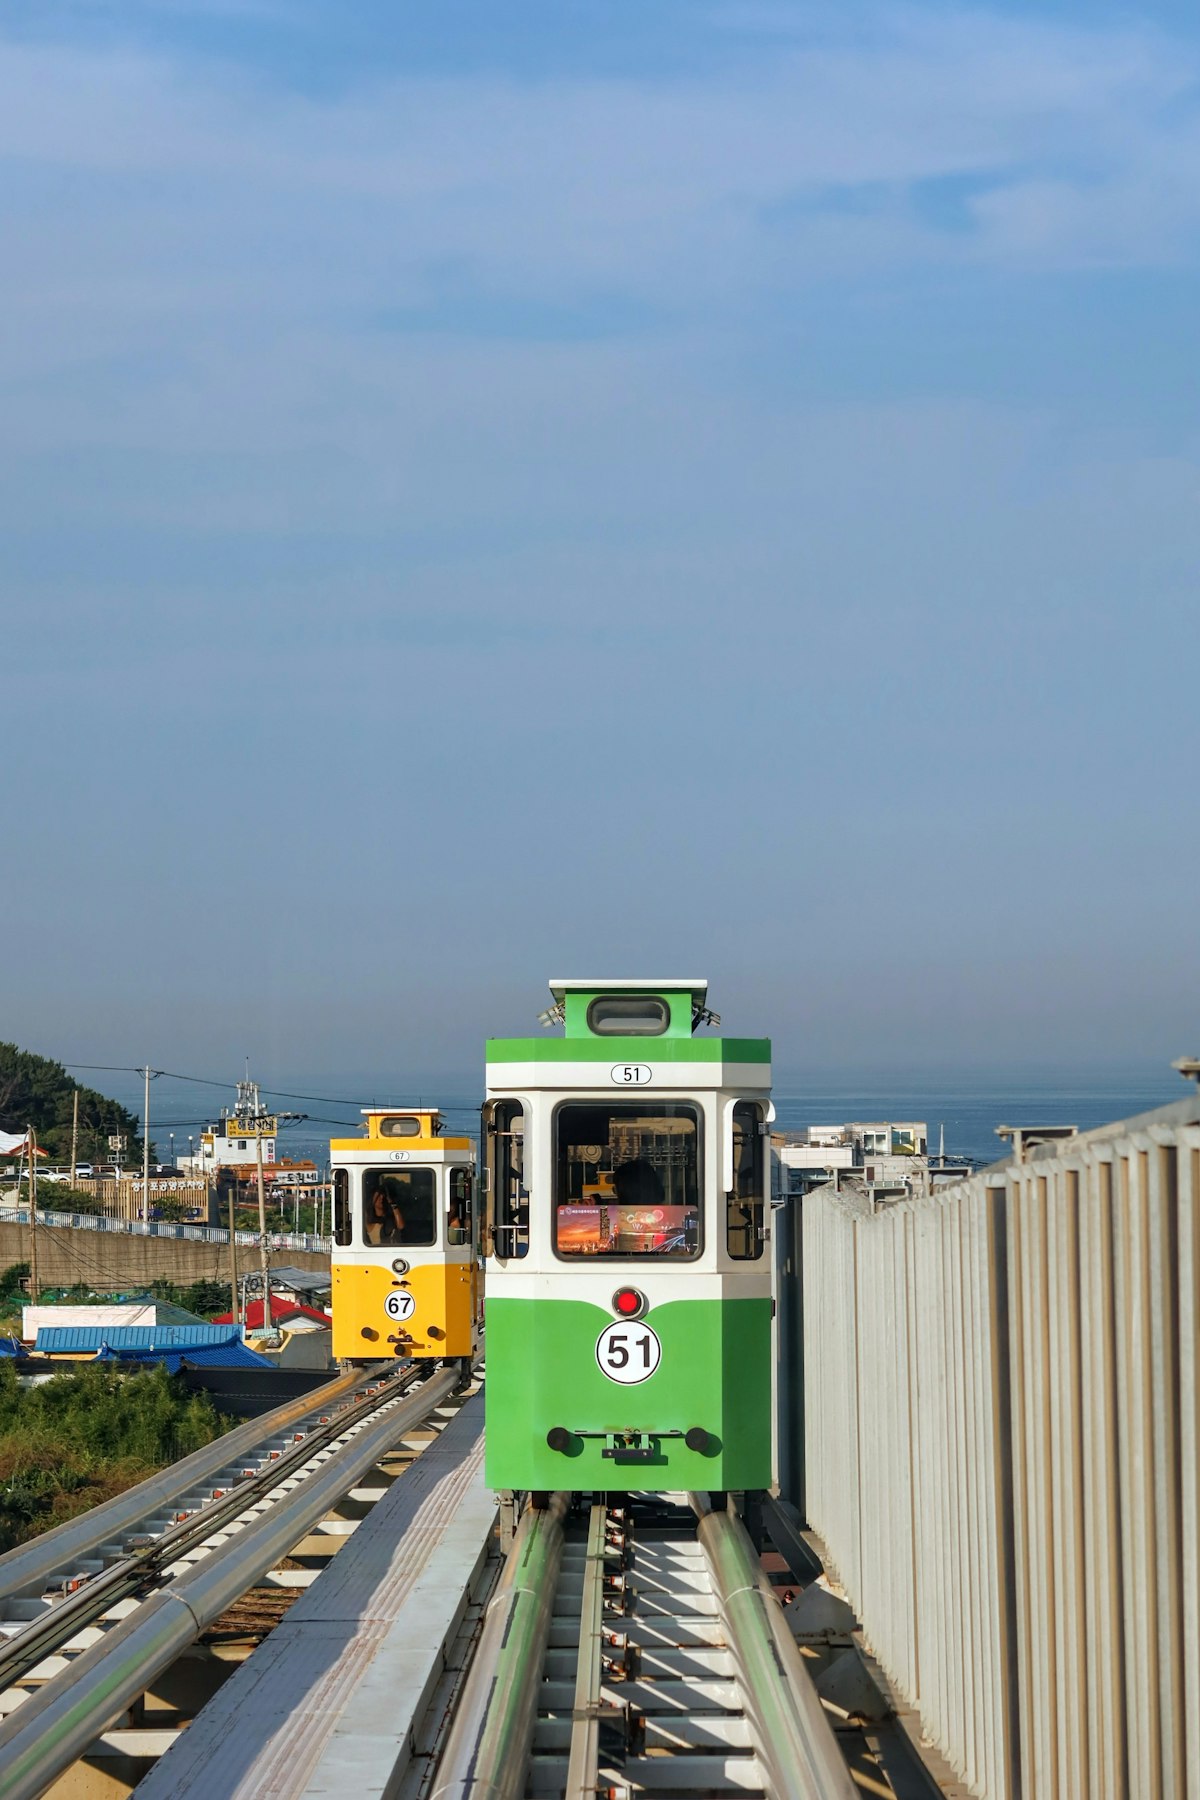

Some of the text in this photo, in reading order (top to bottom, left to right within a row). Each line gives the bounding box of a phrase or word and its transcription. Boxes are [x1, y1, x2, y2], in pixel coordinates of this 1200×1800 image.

[624, 1067, 639, 1082] 51
[395, 1152, 404, 1160] 67
[388, 1297, 411, 1314] 67
[607, 1335, 650, 1369] 51
